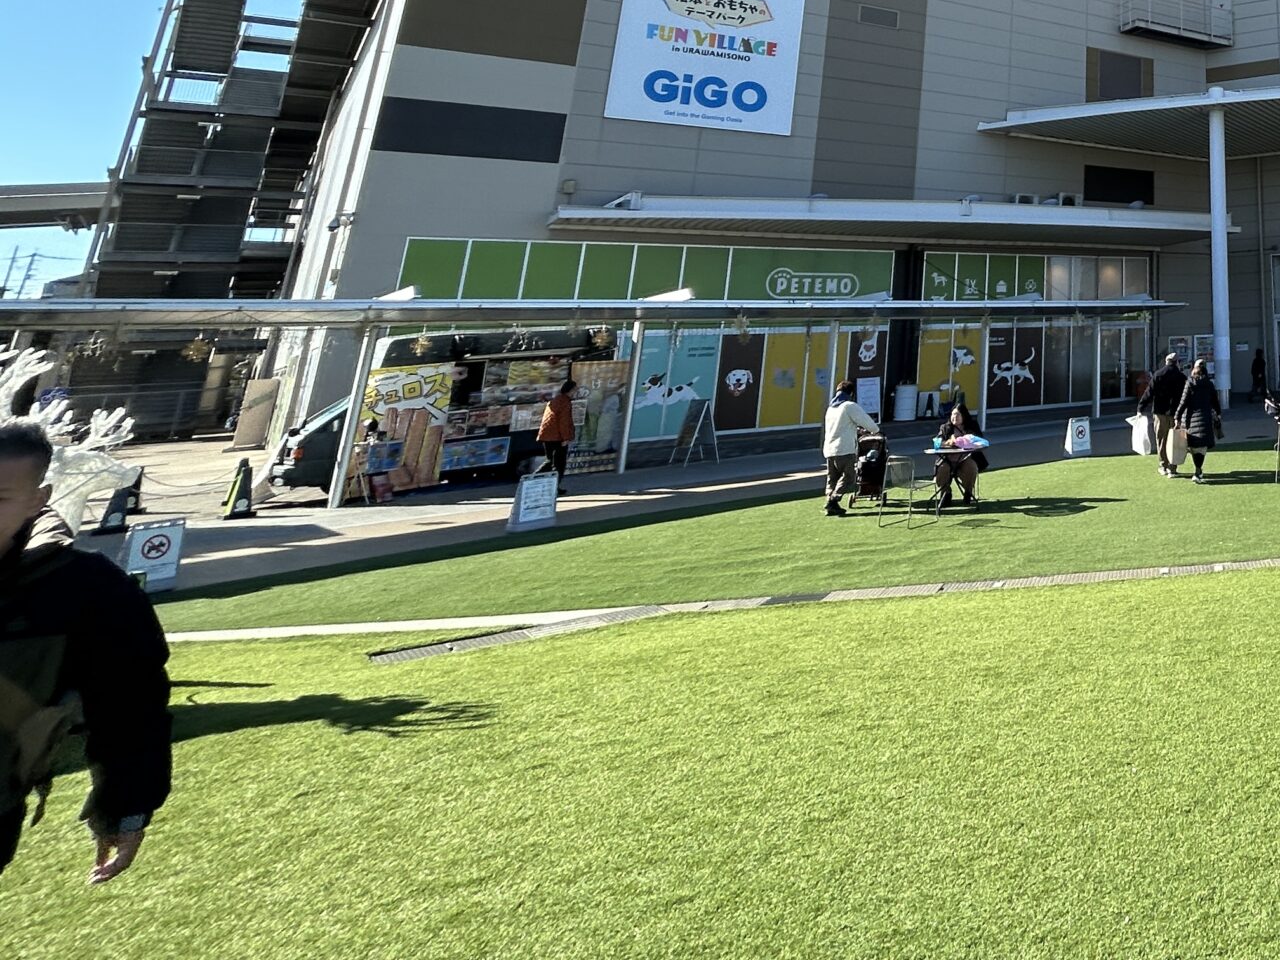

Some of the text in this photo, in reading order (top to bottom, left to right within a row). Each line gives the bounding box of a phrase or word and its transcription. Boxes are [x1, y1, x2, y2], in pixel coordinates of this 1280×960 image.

[685, 6, 746, 25] テーマパーク
[646, 23, 778, 57] FUN VILLAGE
[672, 44, 751, 62] in URAWAMISONO
[643, 69, 768, 113] GiGO
[775, 277, 852, 294] PETEMO
